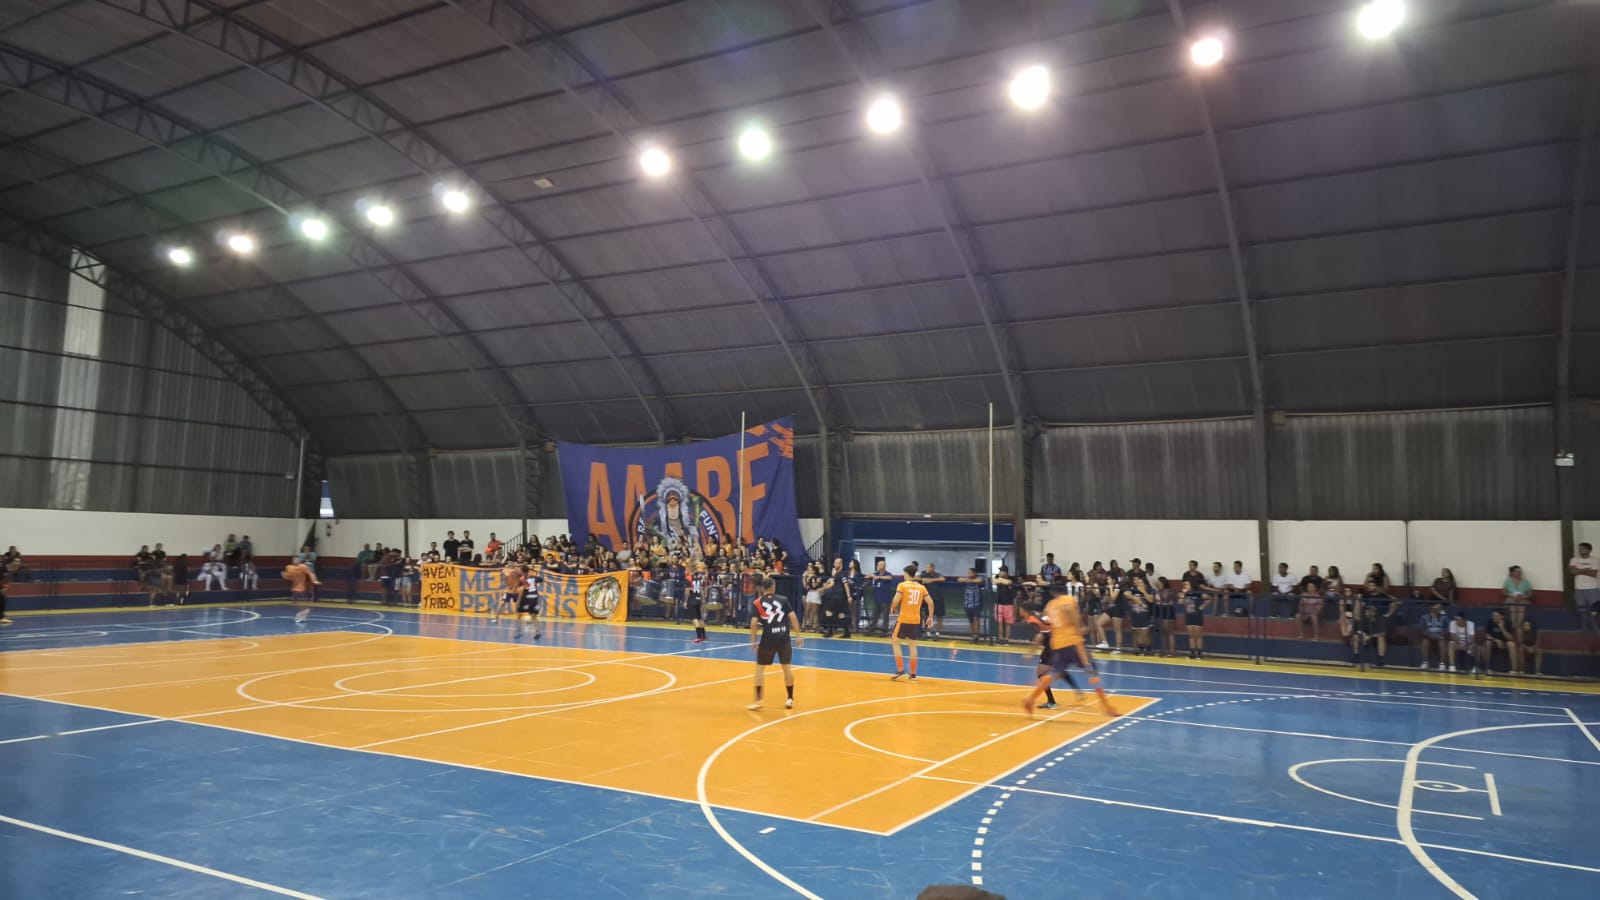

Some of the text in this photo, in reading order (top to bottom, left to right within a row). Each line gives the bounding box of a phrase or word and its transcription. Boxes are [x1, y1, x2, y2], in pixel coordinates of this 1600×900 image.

[430, 582, 452, 595] PRA
[423, 595, 455, 609] TRIBO
[907, 589, 920, 605] 30
[762, 600, 785, 624] 33
